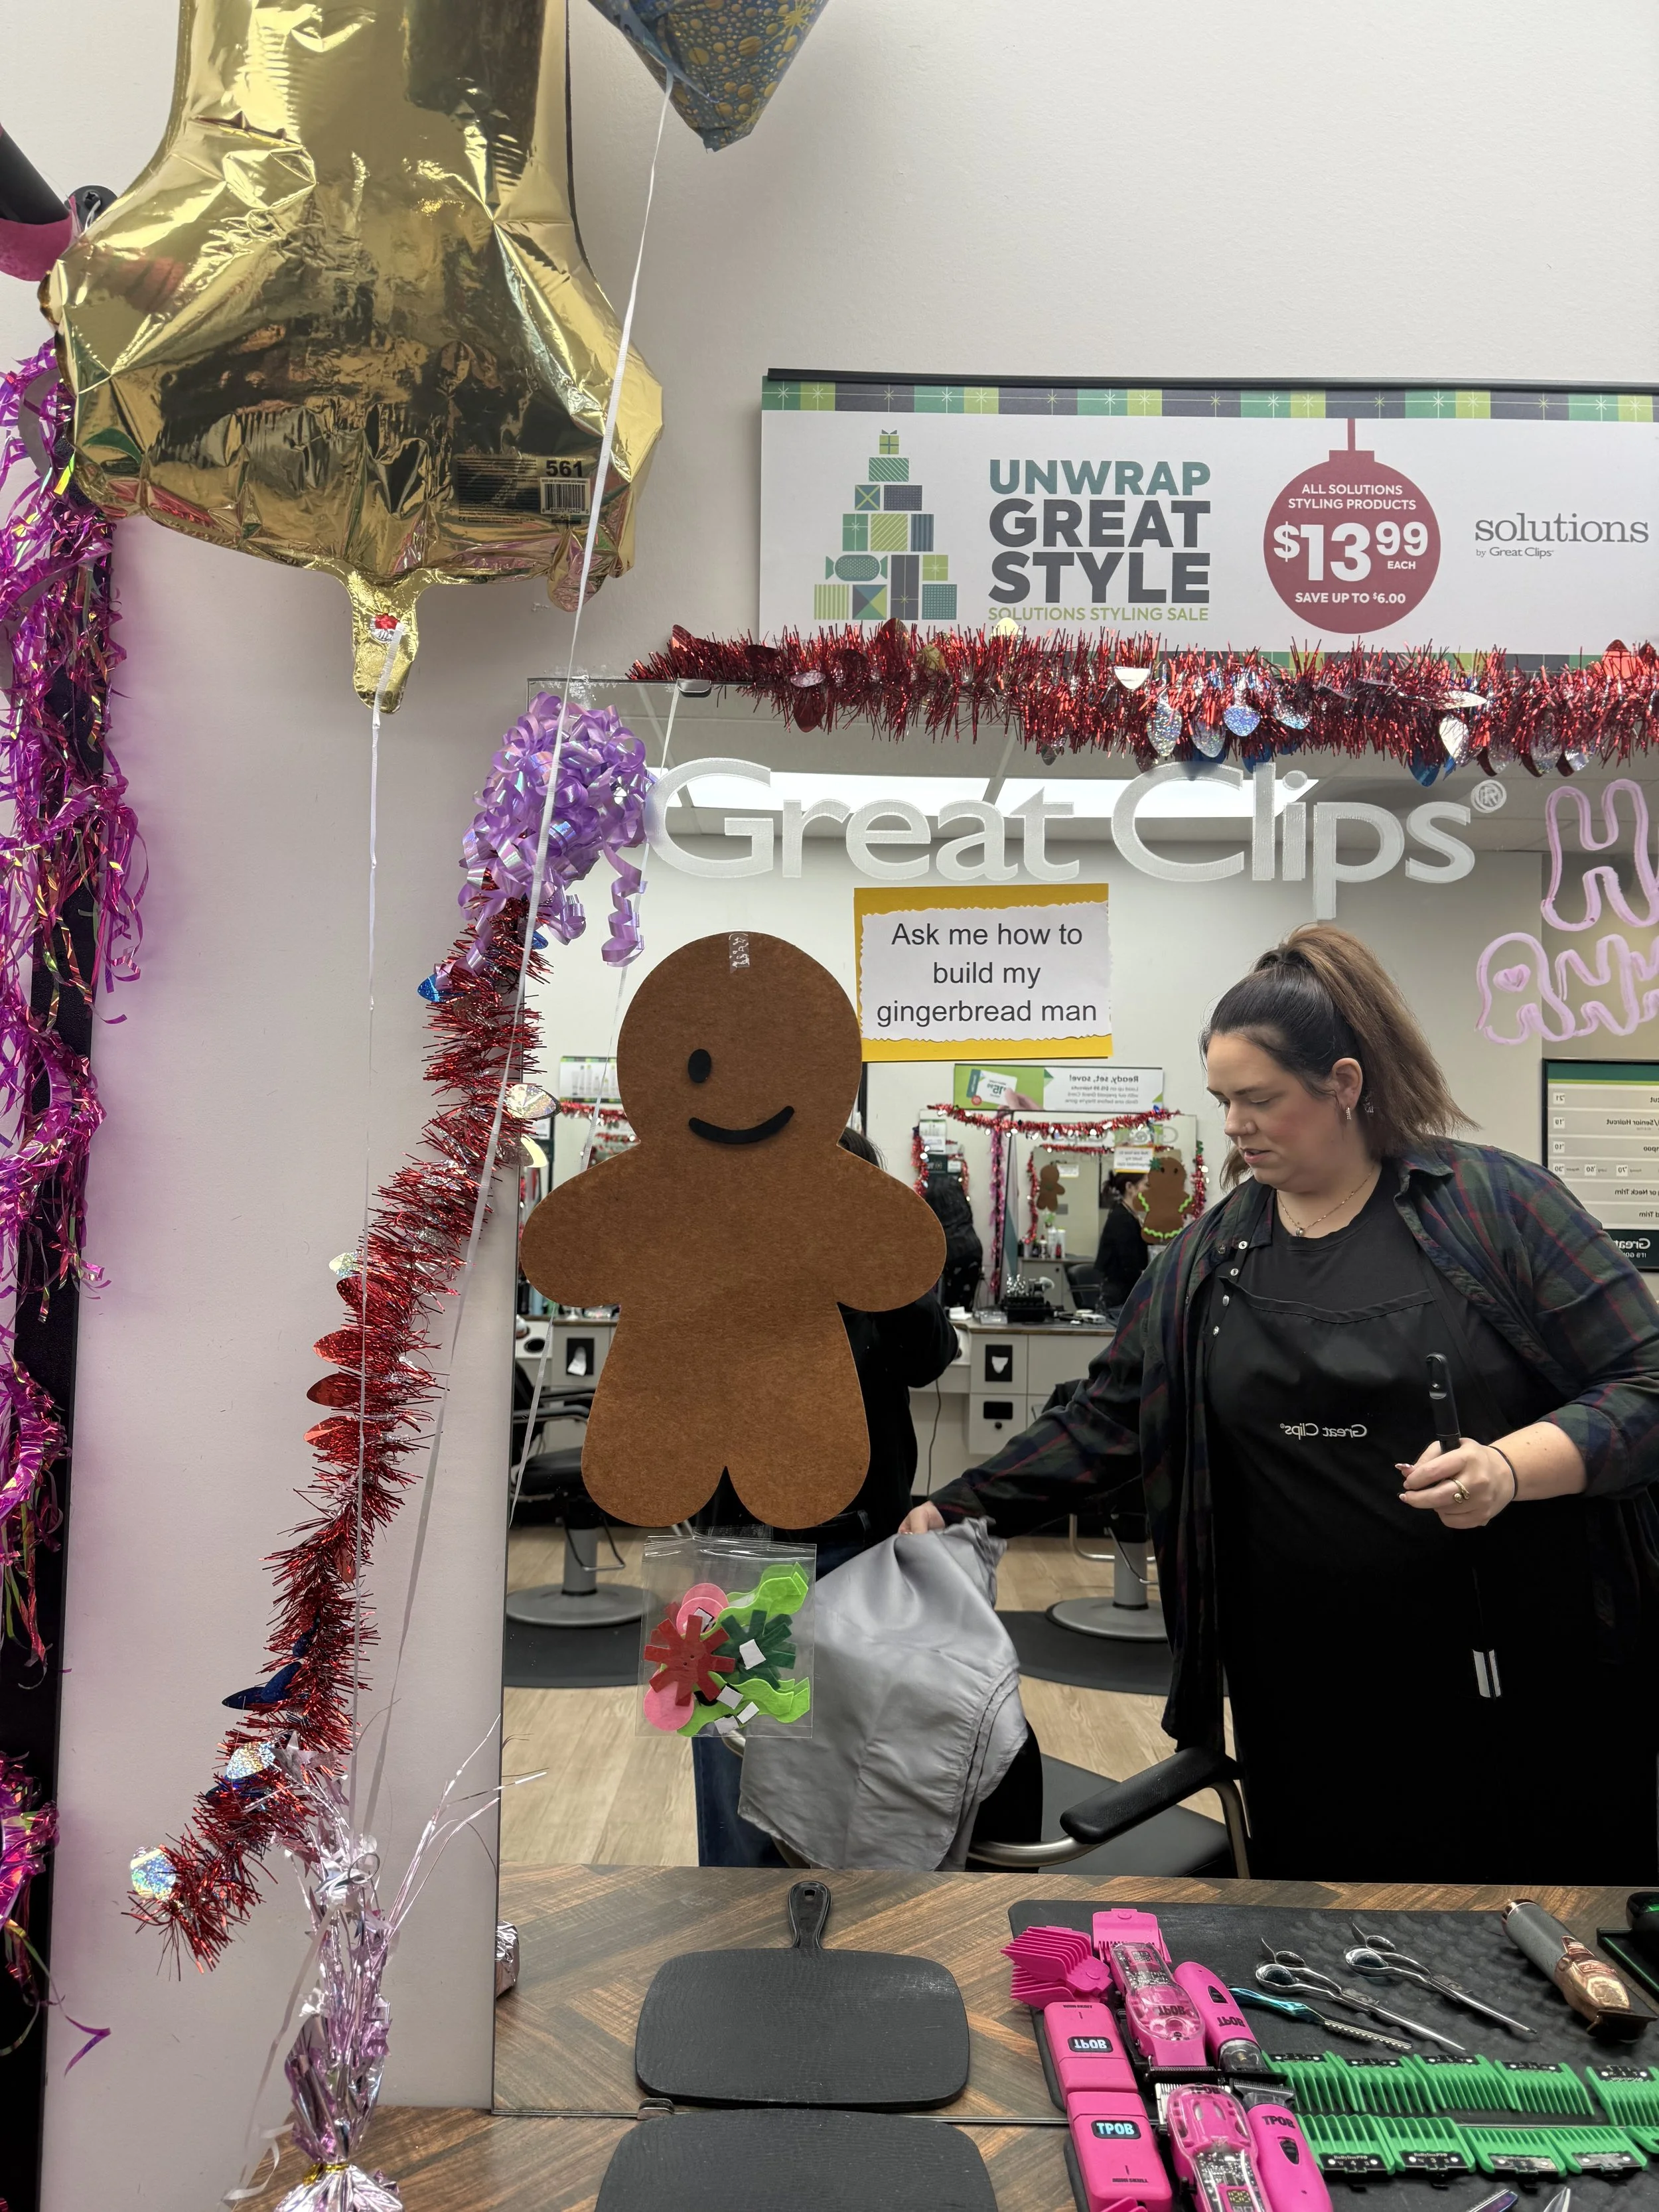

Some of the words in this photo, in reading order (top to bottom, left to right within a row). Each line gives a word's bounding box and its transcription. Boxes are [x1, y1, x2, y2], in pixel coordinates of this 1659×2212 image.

[545, 460, 583, 477] 561
[989, 459, 1210, 496] UNWRAP
[1301, 484, 1327, 494] ALL
[1329, 484, 1403, 495] SOLUTIONS
[1288, 498, 1343, 509] STYLING
[1346, 499, 1417, 510] PRODUCTS
[989, 498, 1211, 548] GREAT
[1475, 512, 1650, 543] solutions
[1476, 548, 1486, 558] by
[1489, 547, 1523, 557] Great
[1387, 561, 1416, 569] EACH
[987, 551, 1211, 605] STYLE
[1295, 592, 1329, 603] SAVE
[1332, 593, 1350, 603] UP
[1350, 593, 1370, 603] TO
[1372, 592, 1406, 604] $6.00
[987, 607, 1086, 621] SOLUTIONS
[1090, 607, 1163, 621] STYLING
[1167, 607, 1209, 621] SALE
[643, 757, 1080, 881] Great
[891, 922, 938, 946] Ask
[948, 927, 989, 946] me
[997, 923, 1049, 946] how
[1058, 924, 1083, 946] to
[932, 962, 994, 984] build
[1002, 968, 1041, 990] my
[876, 1000, 1032, 1028] gingerbread
[1041, 1004, 1097, 1021] man
[1096, 2122, 1135, 2136] TPOB
[1262, 2115, 1296, 2129] TPOB
